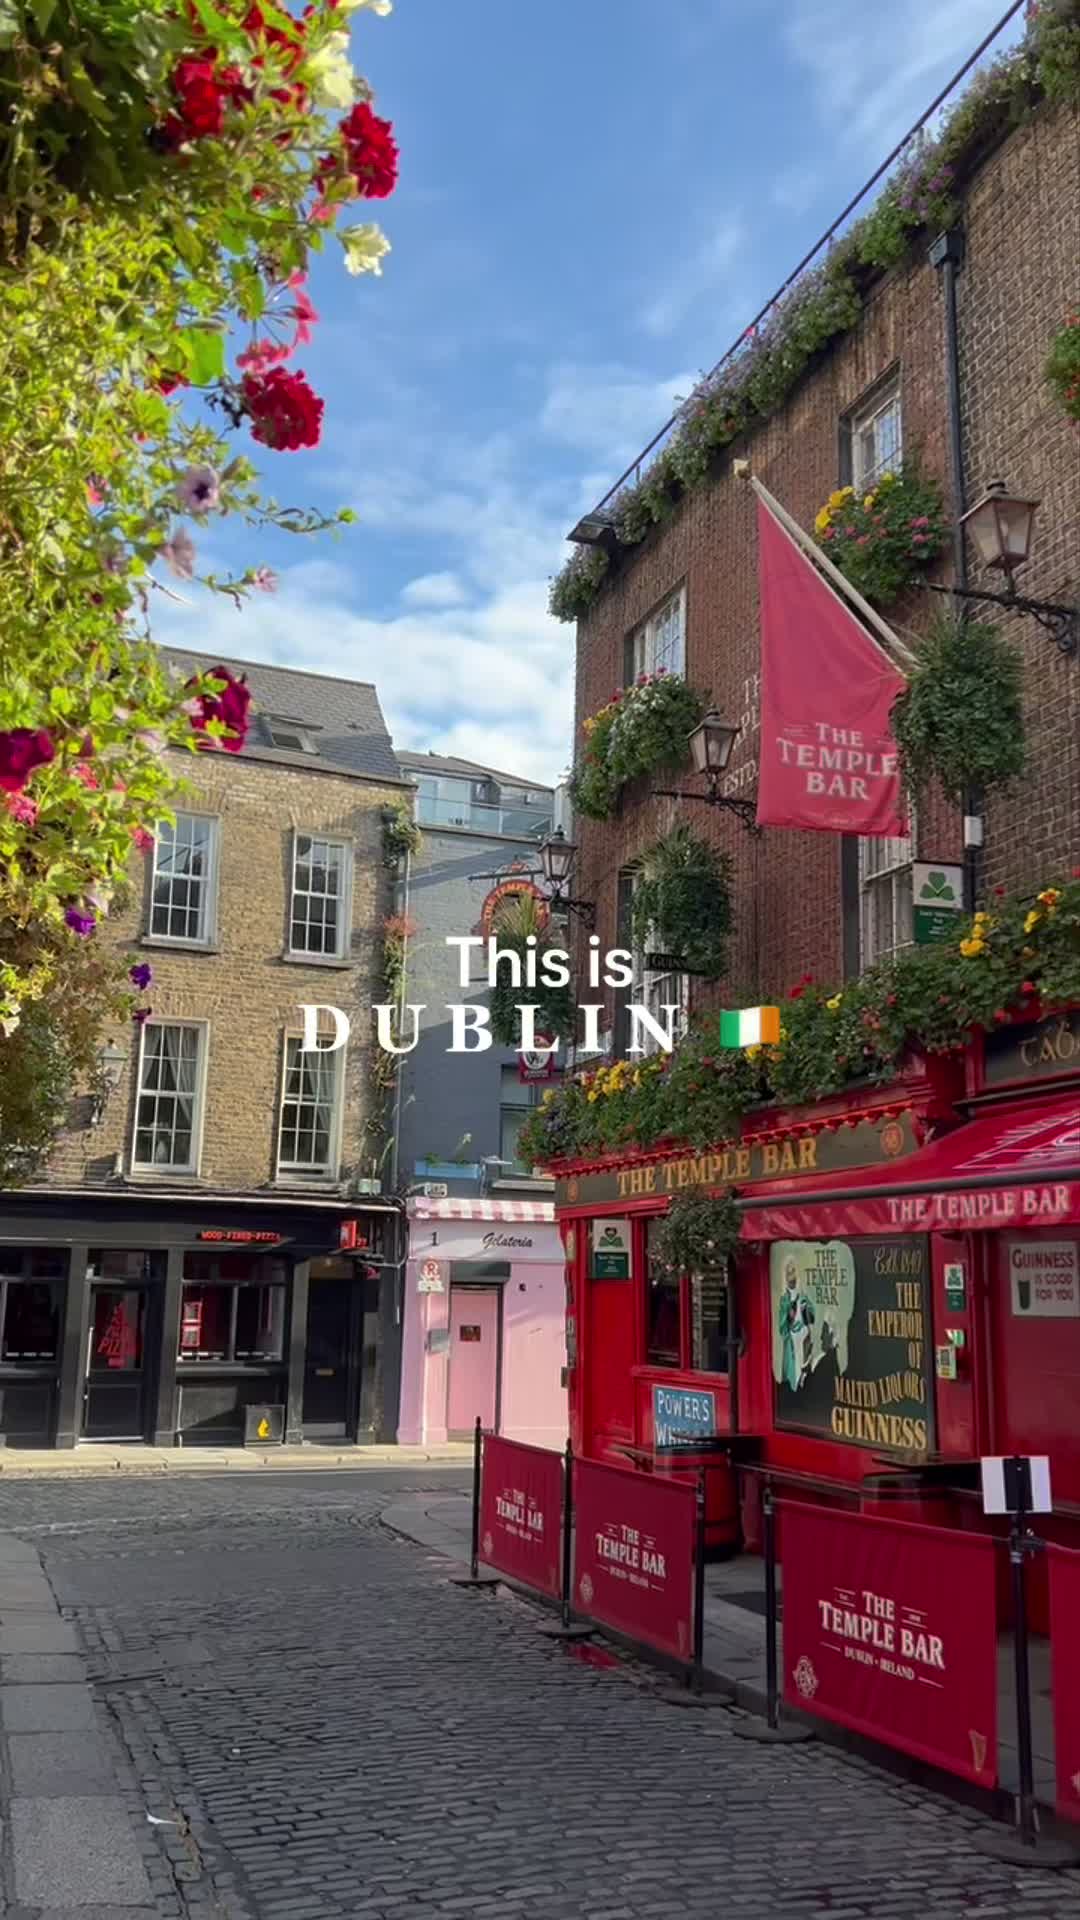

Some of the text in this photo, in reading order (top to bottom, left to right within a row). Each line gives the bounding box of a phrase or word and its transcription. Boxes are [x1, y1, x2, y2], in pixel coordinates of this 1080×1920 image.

[815, 721, 864, 747] THE
[775, 737, 898, 776] TEMPLE
[806, 771, 872, 800] BAR
[617, 1137, 818, 1194] THE TEMPLE BAR
[887, 1184, 1071, 1224] THE TEMPLE BAR
[430, 1231, 534, 1249] 1 Gelateria
[814, 1249, 838, 1268] THE
[805, 1268, 849, 1287] TEMPLE
[1045, 1272, 1073, 1285] GOOD
[815, 1287, 839, 1306] BAR
[895, 1282, 921, 1309] THE
[1035, 1288, 1074, 1301] FOR YOU
[867, 1310, 923, 1340] EMPEROR
[908, 1341, 923, 1369] OF
[834, 1376, 879, 1407] MALTED
[831, 1406, 927, 1450] GUINNESS
[621, 1524, 640, 1546] THE
[595, 1532, 639, 1569] TEMPLE
[641, 1550, 666, 1579] BAR
[862, 1591, 895, 1621] THE
[818, 1600, 946, 1670] TEMPLE BAR
